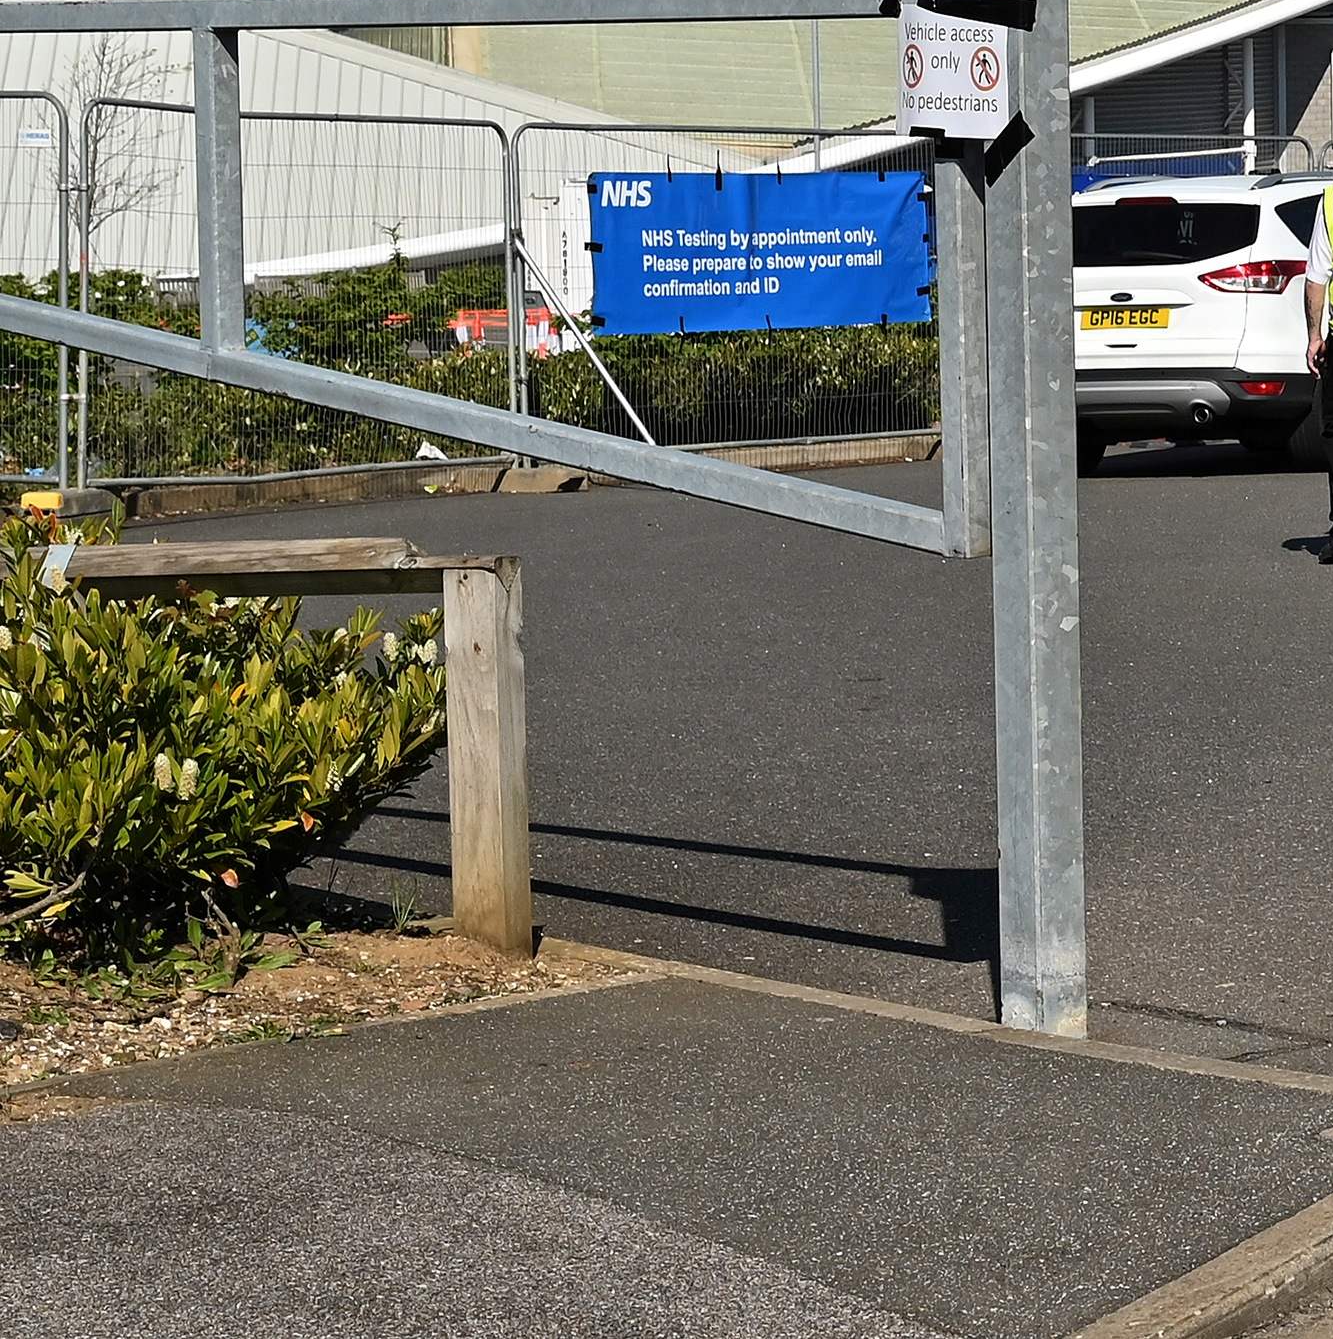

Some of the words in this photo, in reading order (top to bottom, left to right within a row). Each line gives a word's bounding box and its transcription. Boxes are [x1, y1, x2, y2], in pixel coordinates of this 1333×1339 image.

[904, 22, 946, 41] Vehicle
[950, 27, 994, 43] access
[931, 51, 960, 74] only
[903, 92, 915, 109] No
[918, 91, 998, 113] pedestrians
[601, 180, 652, 208] NHS
[642, 230, 673, 247] NHS
[677, 229, 726, 250] Testing
[731, 229, 749, 250] by
[751, 228, 841, 249] appointment
[844, 227, 877, 249] only.
[643, 255, 689, 272] Please
[692, 255, 746, 274] prepare
[750, 253, 763, 270] to
[766, 251, 805, 270] show
[809, 252, 842, 272] your
[845, 249, 882, 266] email
[643, 279, 730, 297] confirmation
[735, 278, 760, 295] and
[764, 277, 779, 294] ID
[1090, 310, 1124, 326] GP16
[1128, 310, 1159, 325] EGC
